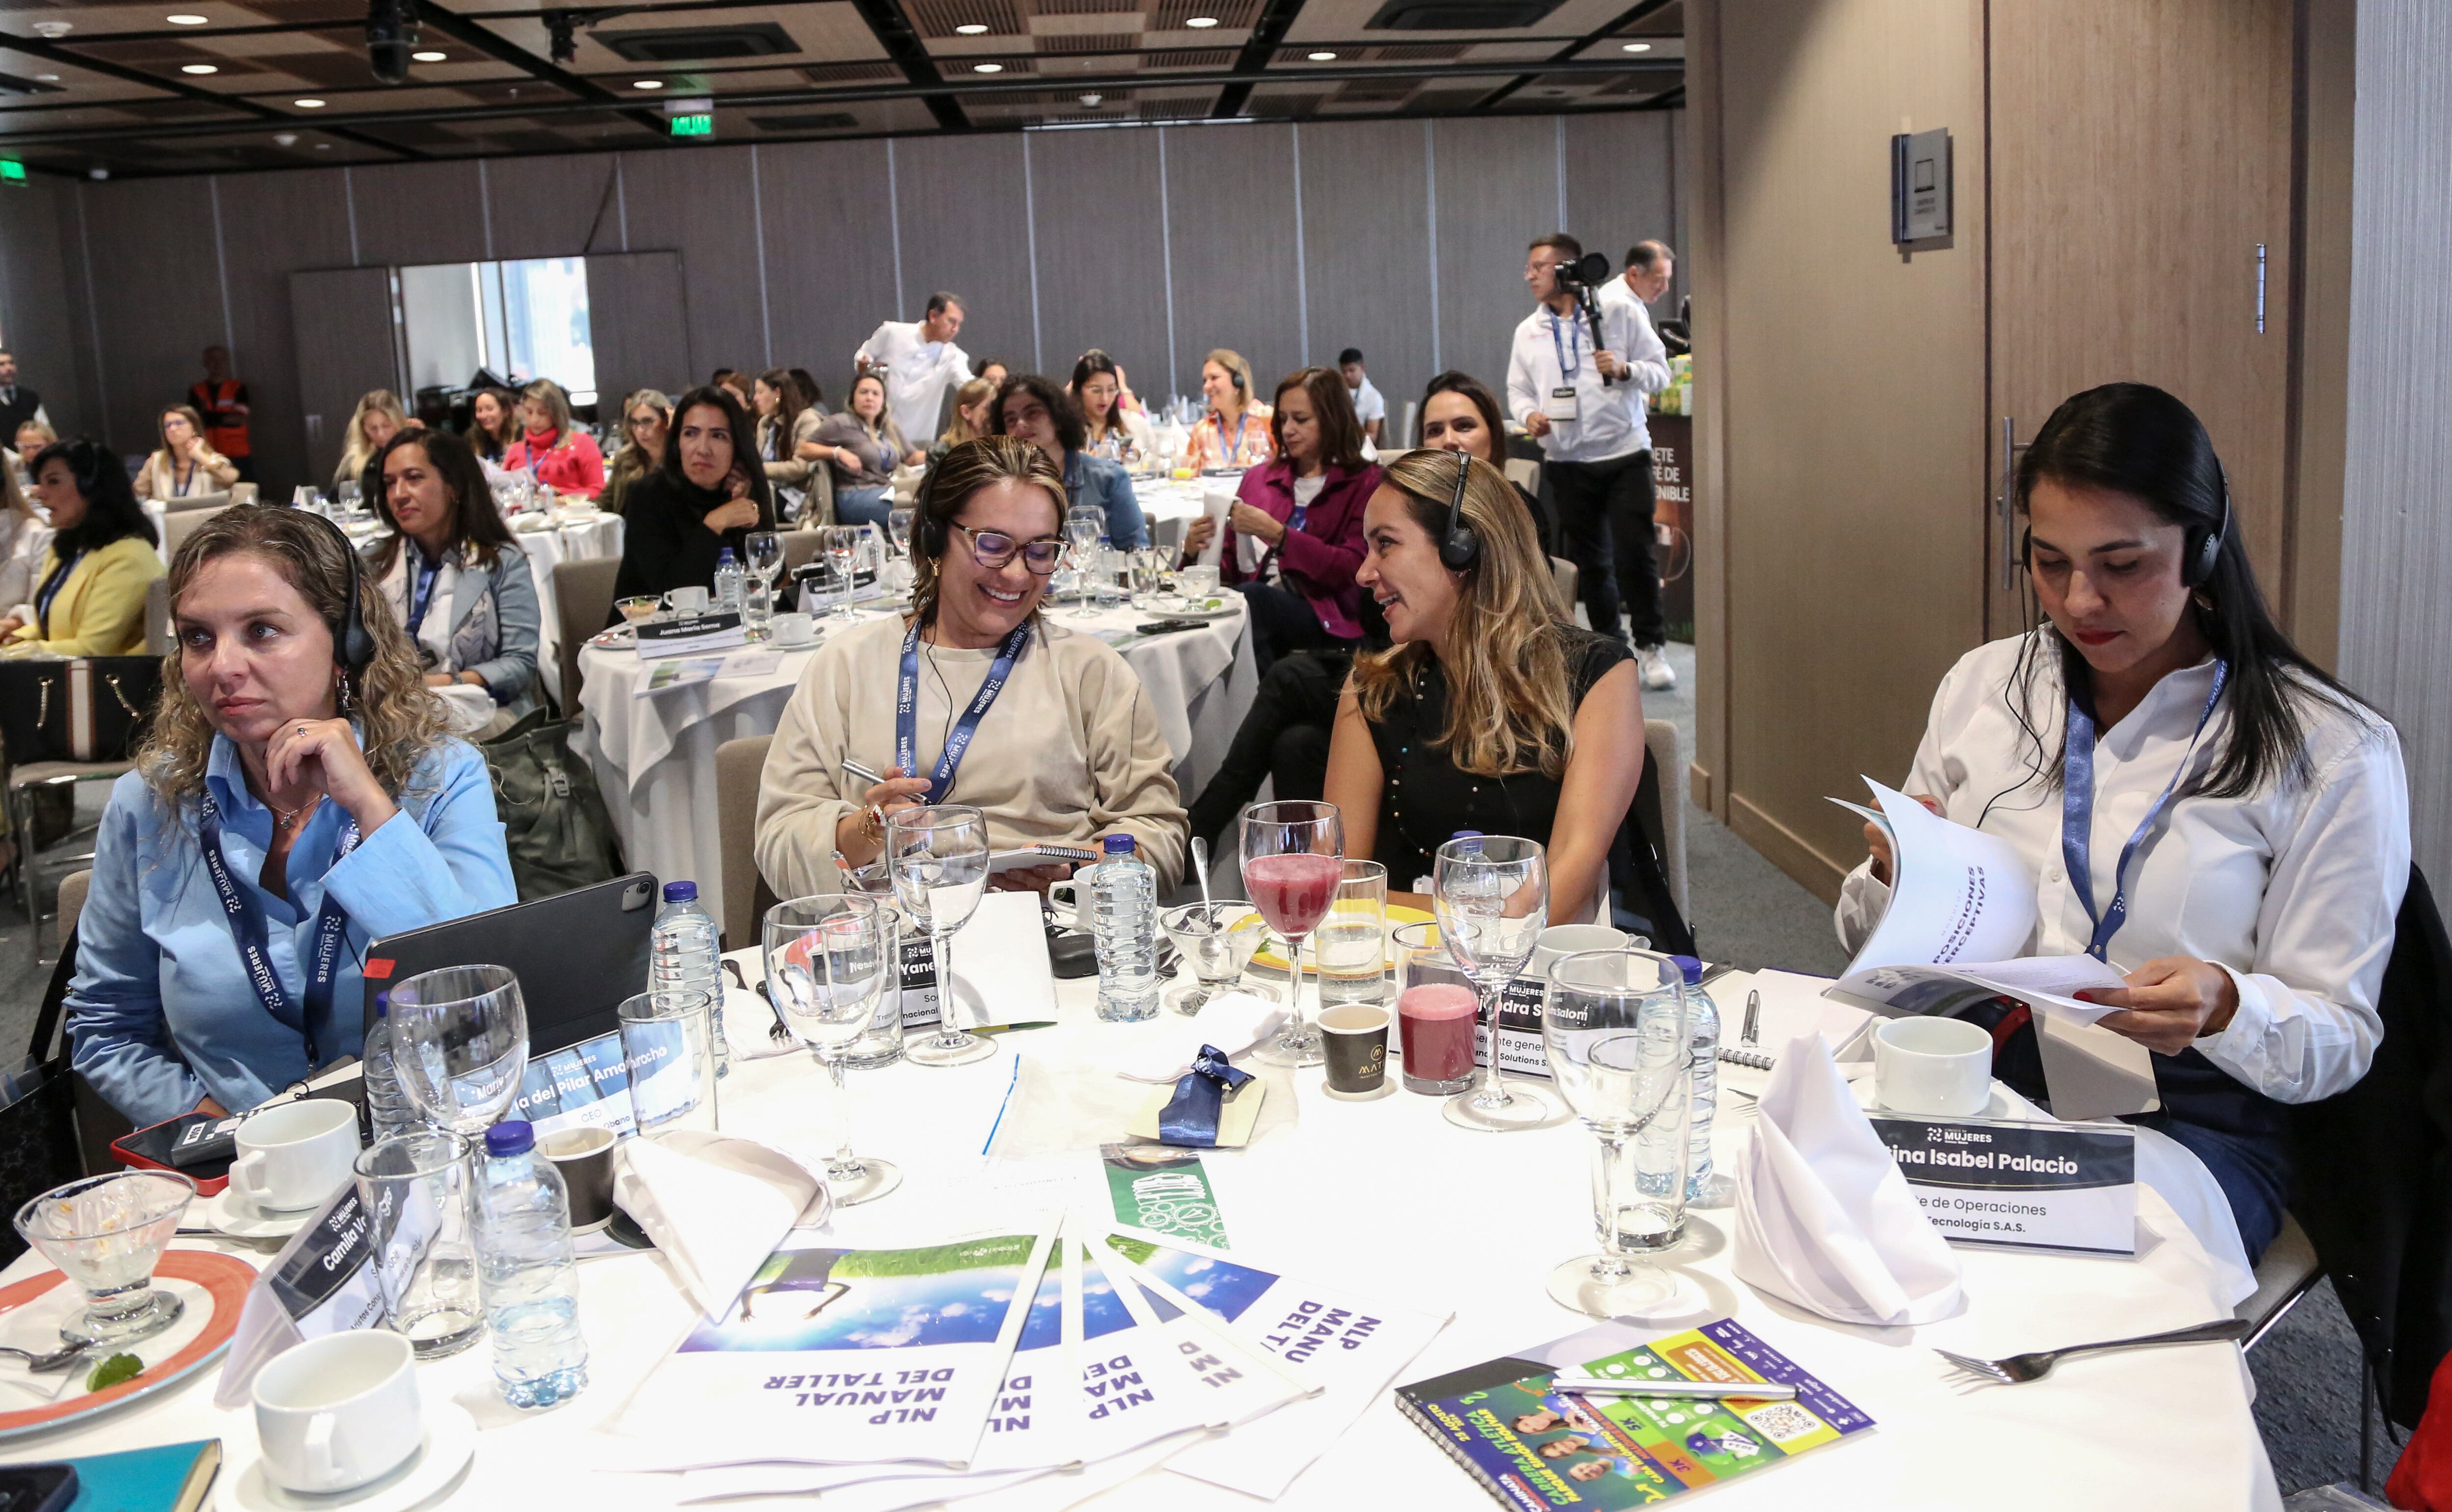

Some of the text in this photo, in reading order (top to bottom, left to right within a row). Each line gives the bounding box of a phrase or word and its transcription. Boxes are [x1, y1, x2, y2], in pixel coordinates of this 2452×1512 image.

[1664, 467, 1681, 483] DE
[701, 622, 721, 630] Serna
[1006, 630, 1025, 658] MUJERES
[901, 676, 911, 703] MUJERES
[973, 689, 995, 714] MUJERES
[208, 849, 232, 897] MUJERES
[1932, 866, 1975, 964] POSICIONES
[1942, 866, 1986, 964] ERCEPTIVAS
[247, 945, 273, 993] MUJERES
[317, 933, 335, 983] MUJERES
[1509, 985, 1544, 997] MUJERES
[563, 1054, 597, 1072] MUJERES
[1500, 1053, 1539, 1066] Solutions
[531, 1085, 556, 1103] del
[557, 1073, 591, 1096] Pilar
[581, 1109, 602, 1123] CEO
[1944, 1132, 1993, 1143] MUJERES
[1930, 1148, 1994, 1169] Isabel
[1998, 1153, 2079, 1175] Palacio
[336, 1196, 358, 1223] MUJERES
[1932, 1197, 1950, 1209] de
[1954, 1198, 2047, 1216] Operaciones
[1993, 1221, 2026, 1233] S.A.S.
[323, 1228, 359, 1272] Camila
[1259, 1300, 1324, 1353] DEL T
[1284, 1308, 1353, 1364] MANU
[1338, 1315, 1383, 1351] NLP
[1687, 1348, 1732, 1378] SOLIDARIDAD
[763, 1368, 955, 1390] DEL TALLER
[794, 1387, 946, 1407] MANUAL
[1088, 1388, 1154, 1420] NLP
[868, 1408, 937, 1425] NLP
[1427, 1404, 1462, 1431] AGOSTO
[1476, 1408, 1518, 1441] BOLÍVAR
[1618, 1417, 1642, 1431] 5K
[1463, 1411, 1518, 1453] ATLÉTICA
[1509, 1441, 1547, 1468] SIMÓN
[1598, 1430, 1644, 1465] KILÓMETRO
[1638, 1466, 1665, 1482] CADA
[1667, 1458, 1691, 1472] 3K
[1498, 1473, 1543, 1512] CAMINATA
[1511, 1457, 1569, 1505] CARRERA
[1538, 1468, 1582, 1502] PARQUE
